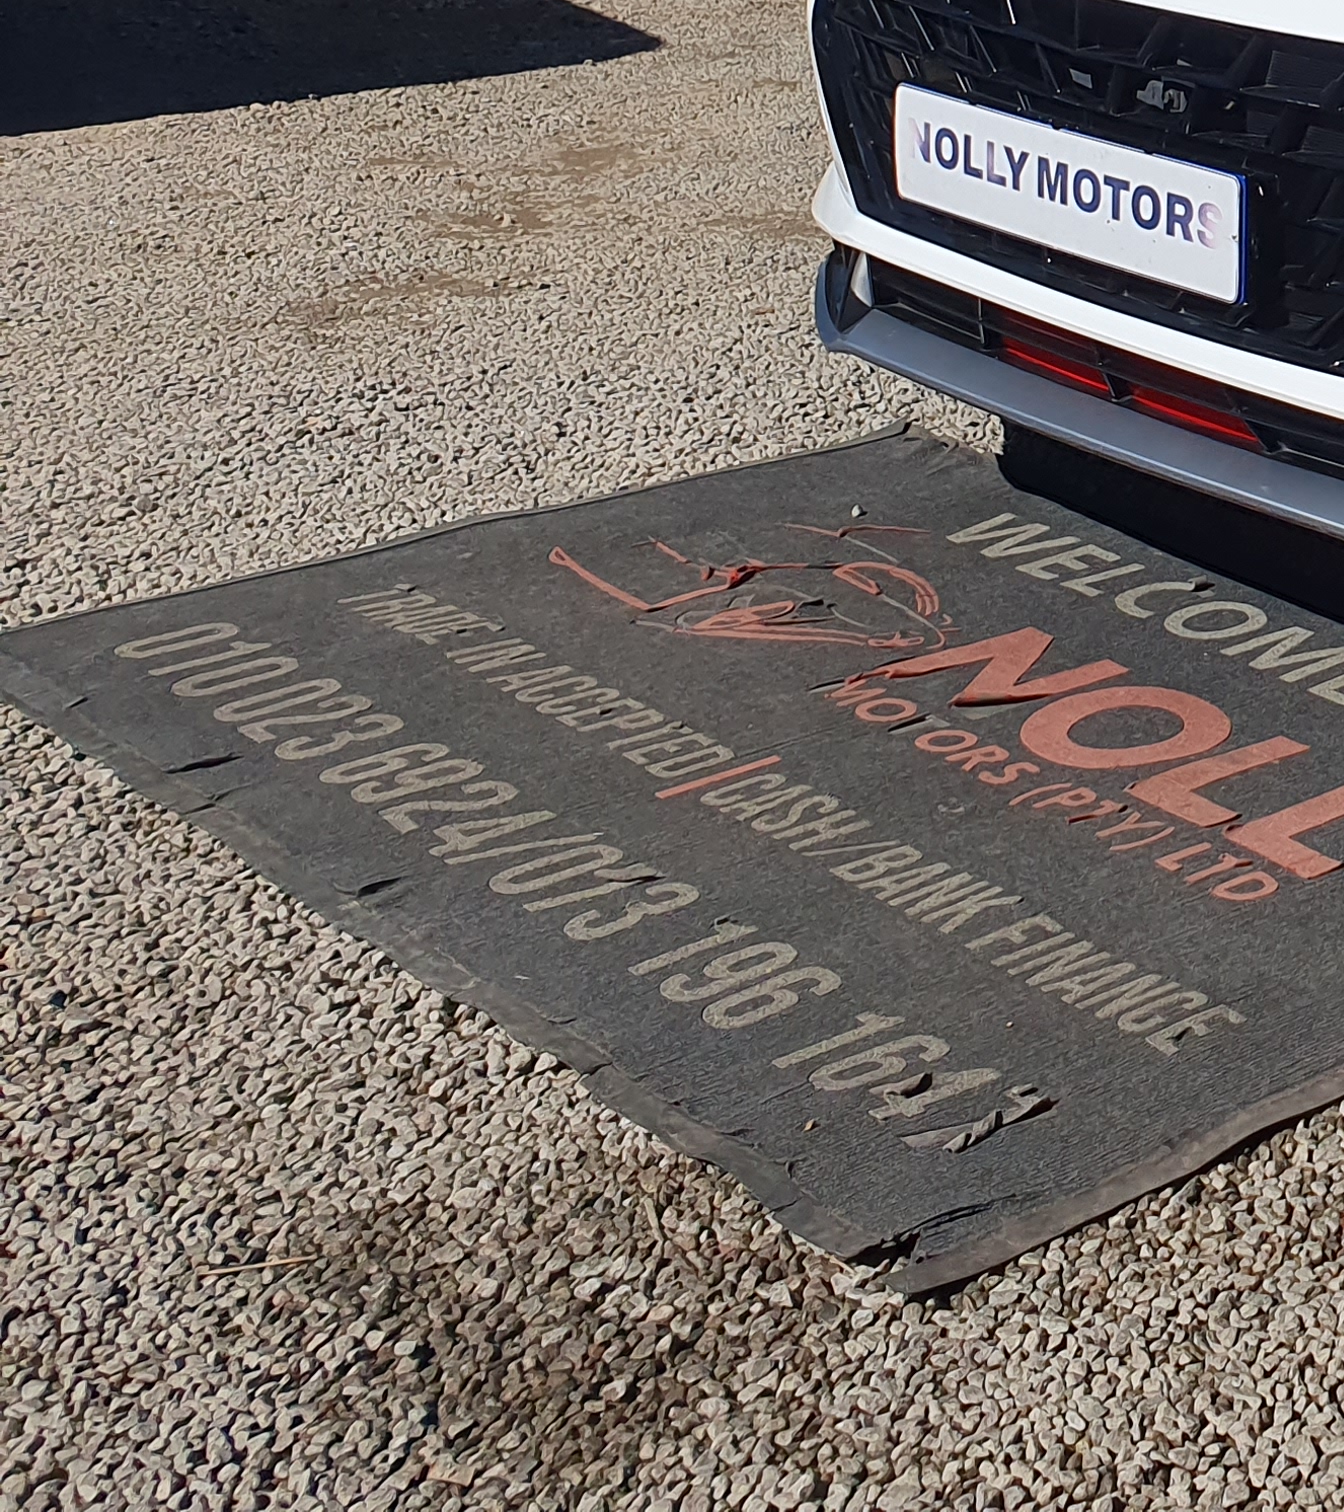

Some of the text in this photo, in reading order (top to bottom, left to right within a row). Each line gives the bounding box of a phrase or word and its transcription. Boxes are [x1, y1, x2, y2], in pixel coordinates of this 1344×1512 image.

[908, 117, 1224, 251] NOLLY MOTORS
[114, 622, 299, 697] 010
[213, 678, 404, 761] 023
[627, 917, 842, 1029] 196
[337, 584, 505, 645] TRADE
[447, 637, 547, 673] IN
[964, 912, 1248, 1056] FINANCE
[1009, 782, 1176, 852] (PTY)
[1155, 841, 1280, 901] LTD
